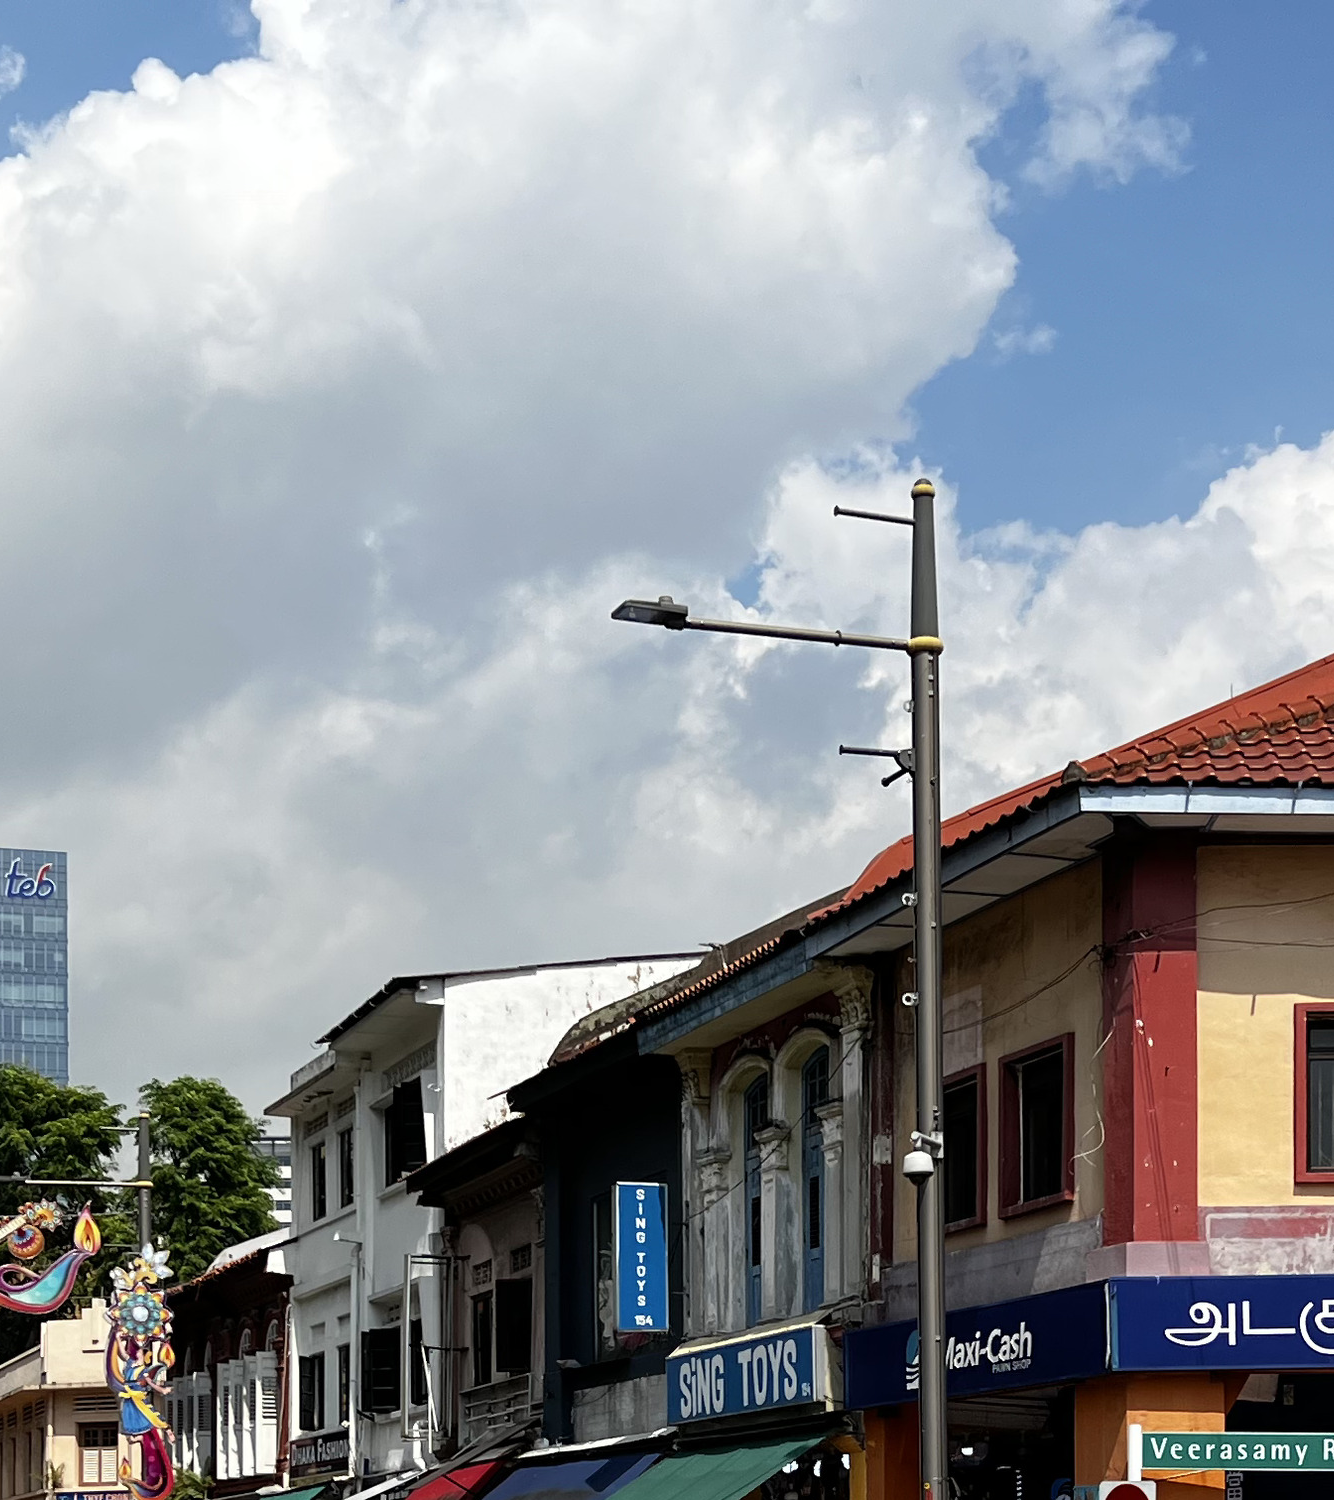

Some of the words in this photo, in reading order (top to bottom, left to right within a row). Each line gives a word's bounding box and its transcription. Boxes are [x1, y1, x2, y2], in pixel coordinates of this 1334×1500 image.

[636, 1252, 647, 1307] TOYS
[634, 1315, 653, 1326] 154
[737, 1338, 798, 1407] TOYS
[991, 1363, 1011, 1374] PAWN
[1012, 1358, 1032, 1372] SHOP
[1150, 1437, 1309, 1466] Veerasamy
